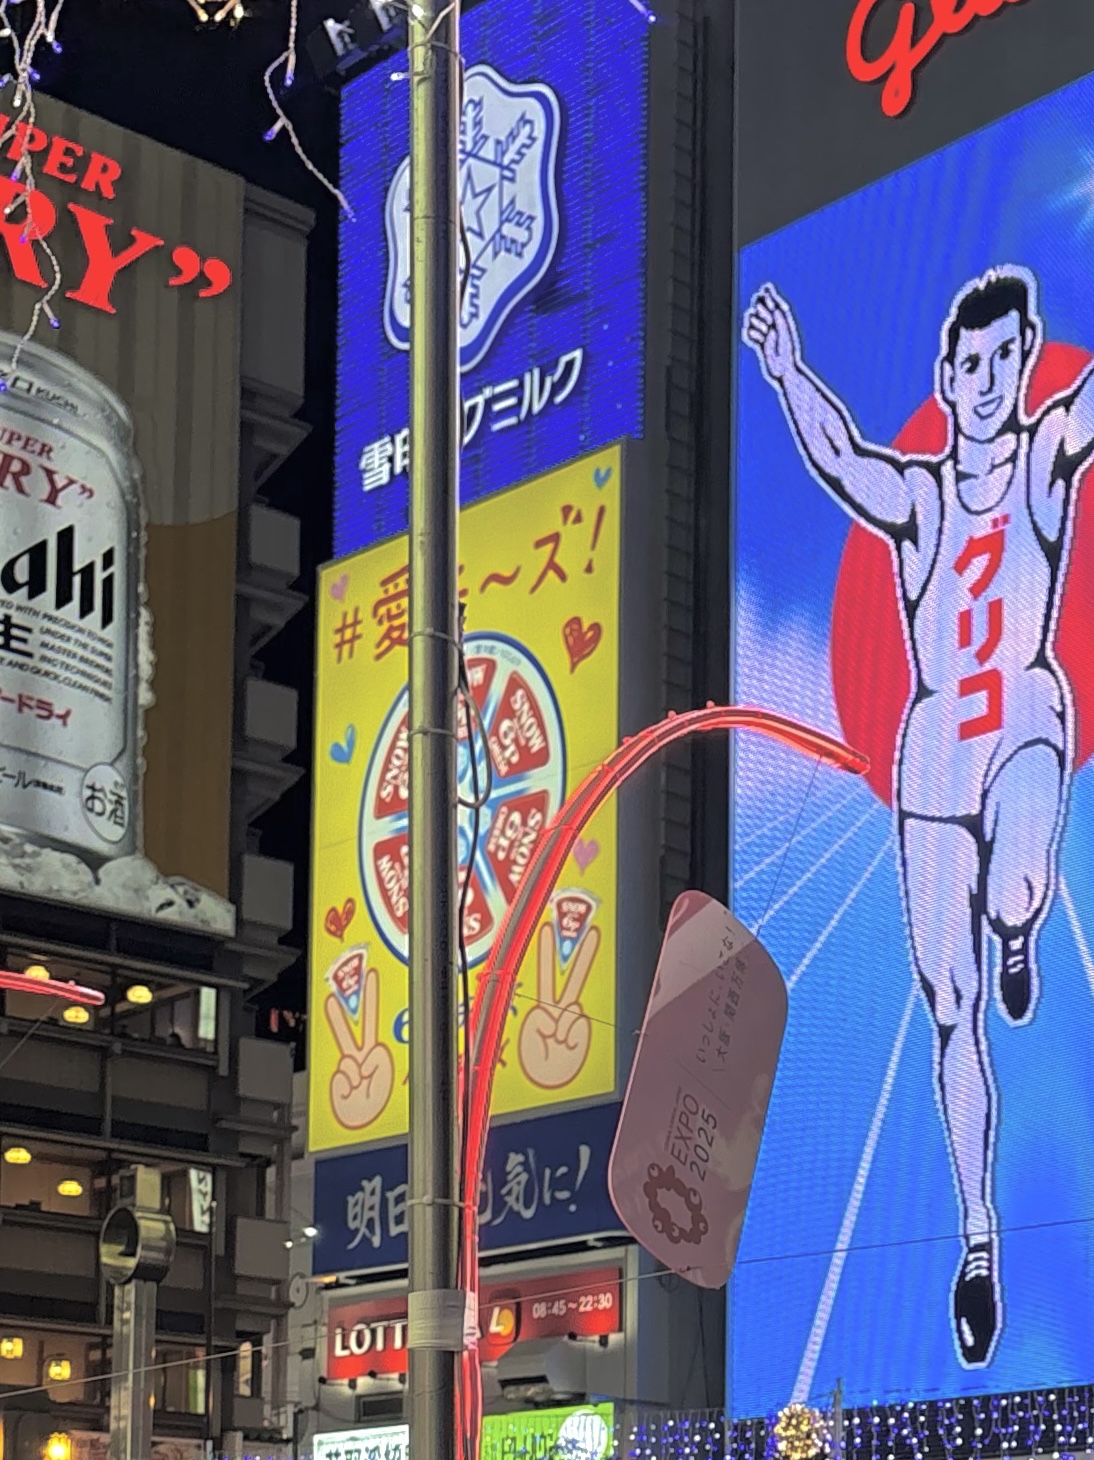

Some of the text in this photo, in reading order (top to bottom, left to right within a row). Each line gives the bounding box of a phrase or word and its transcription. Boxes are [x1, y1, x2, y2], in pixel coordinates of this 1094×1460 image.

[0, 114, 122, 199] PER
[359, 348, 583, 491] 雪グミルク
[954, 514, 1012, 742] グリコ
[670, 1093, 700, 1167] EXPO
[689, 1107, 719, 1183] 2025
[347, 1144, 591, 1250] 明日気に!
